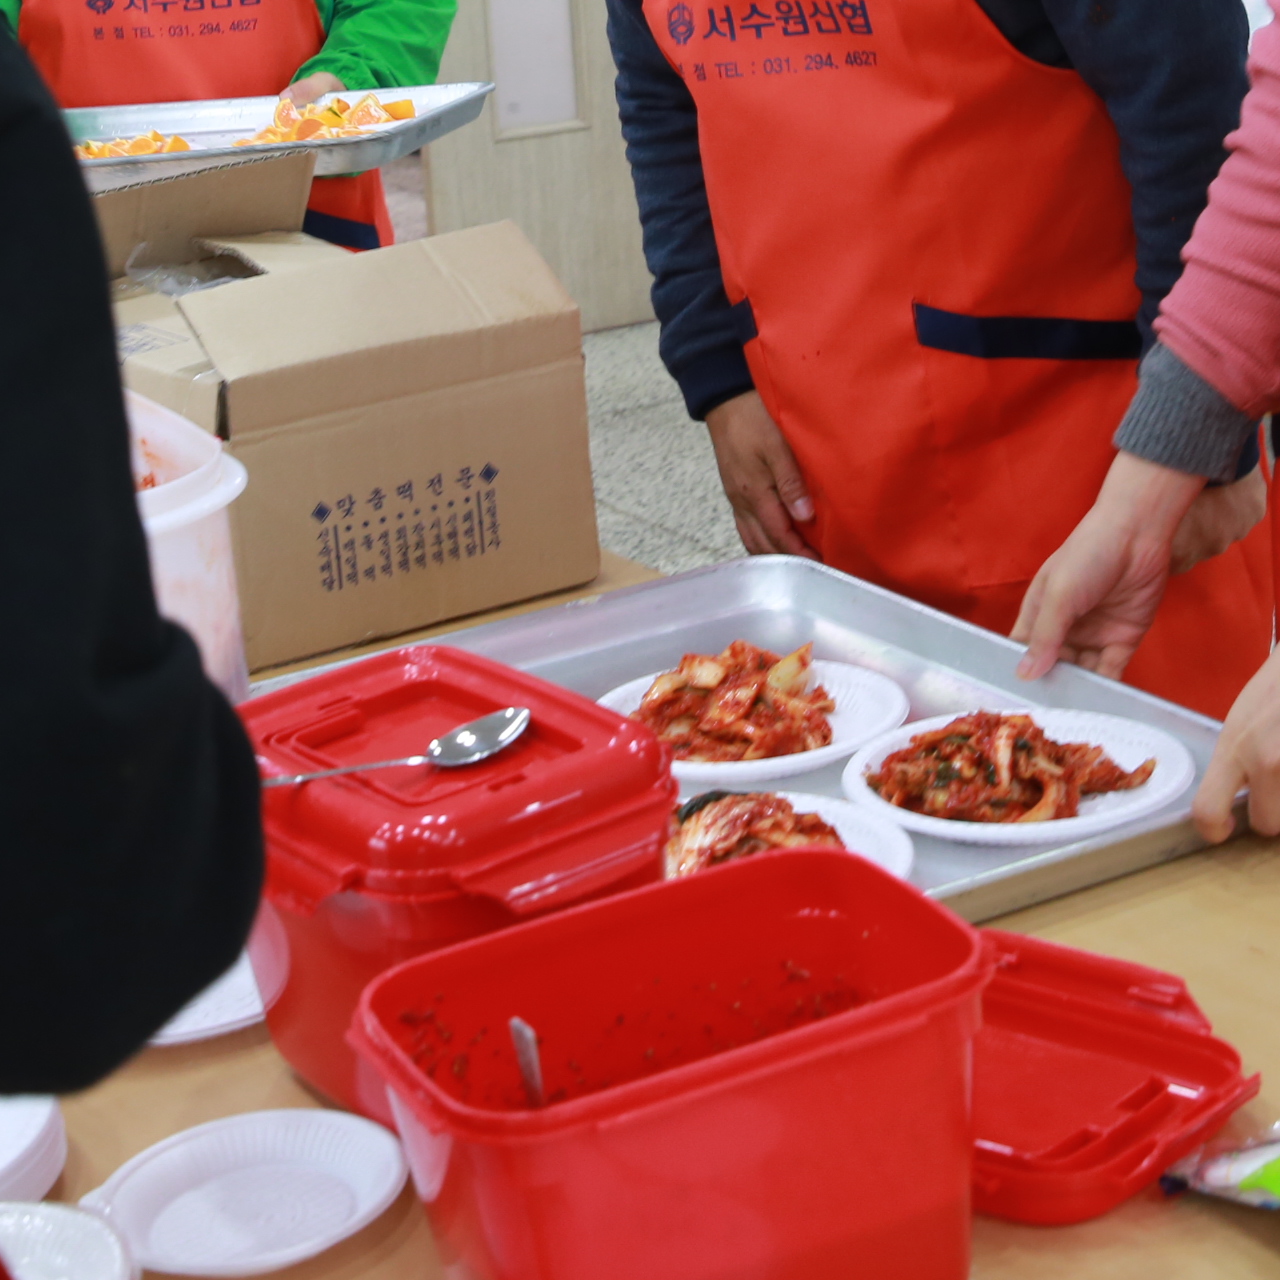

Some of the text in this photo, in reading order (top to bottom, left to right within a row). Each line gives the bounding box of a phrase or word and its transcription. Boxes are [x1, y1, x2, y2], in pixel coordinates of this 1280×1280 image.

[132, 27, 155, 38] TEL
[229, 18, 258, 32] 4627
[715, 61, 744, 78] TEL
[845, 51, 877, 66] 4627
